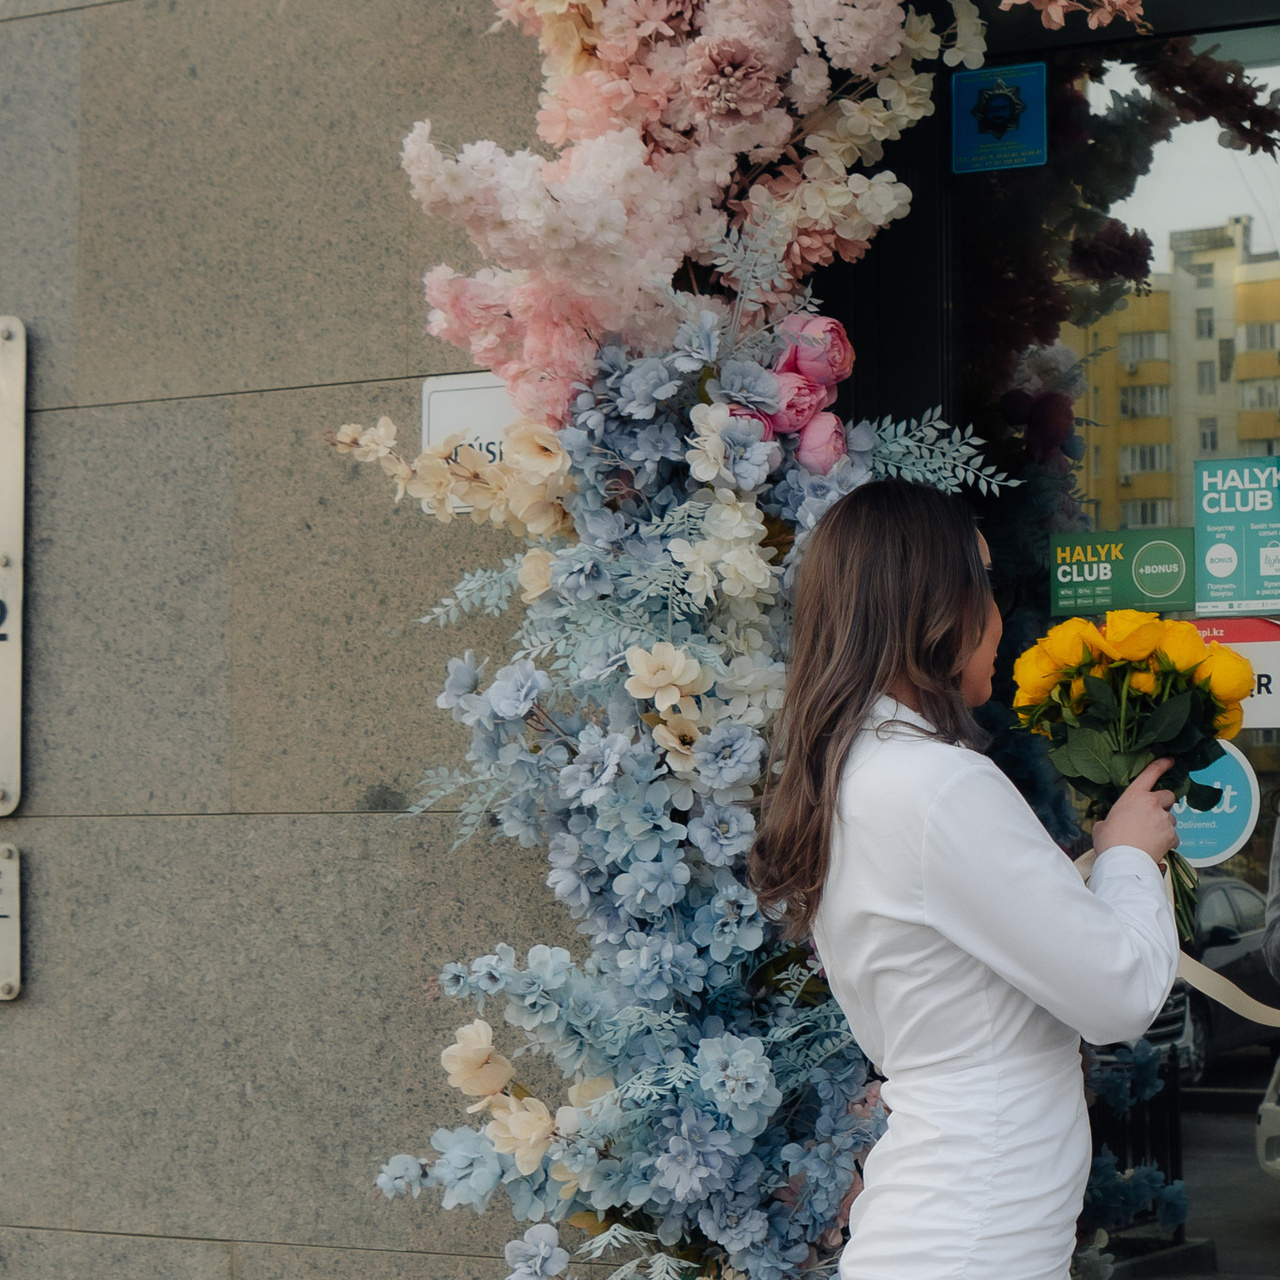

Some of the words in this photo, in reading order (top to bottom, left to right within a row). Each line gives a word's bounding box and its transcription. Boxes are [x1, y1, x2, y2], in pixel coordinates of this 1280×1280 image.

[1202, 490, 1273, 514] CLUB
[1056, 543, 1124, 564] HALYK
[1057, 562, 1112, 583] CLUB
[1138, 564, 1179, 575] +BONUS
[1198, 627, 1225, 639] spi.kz
